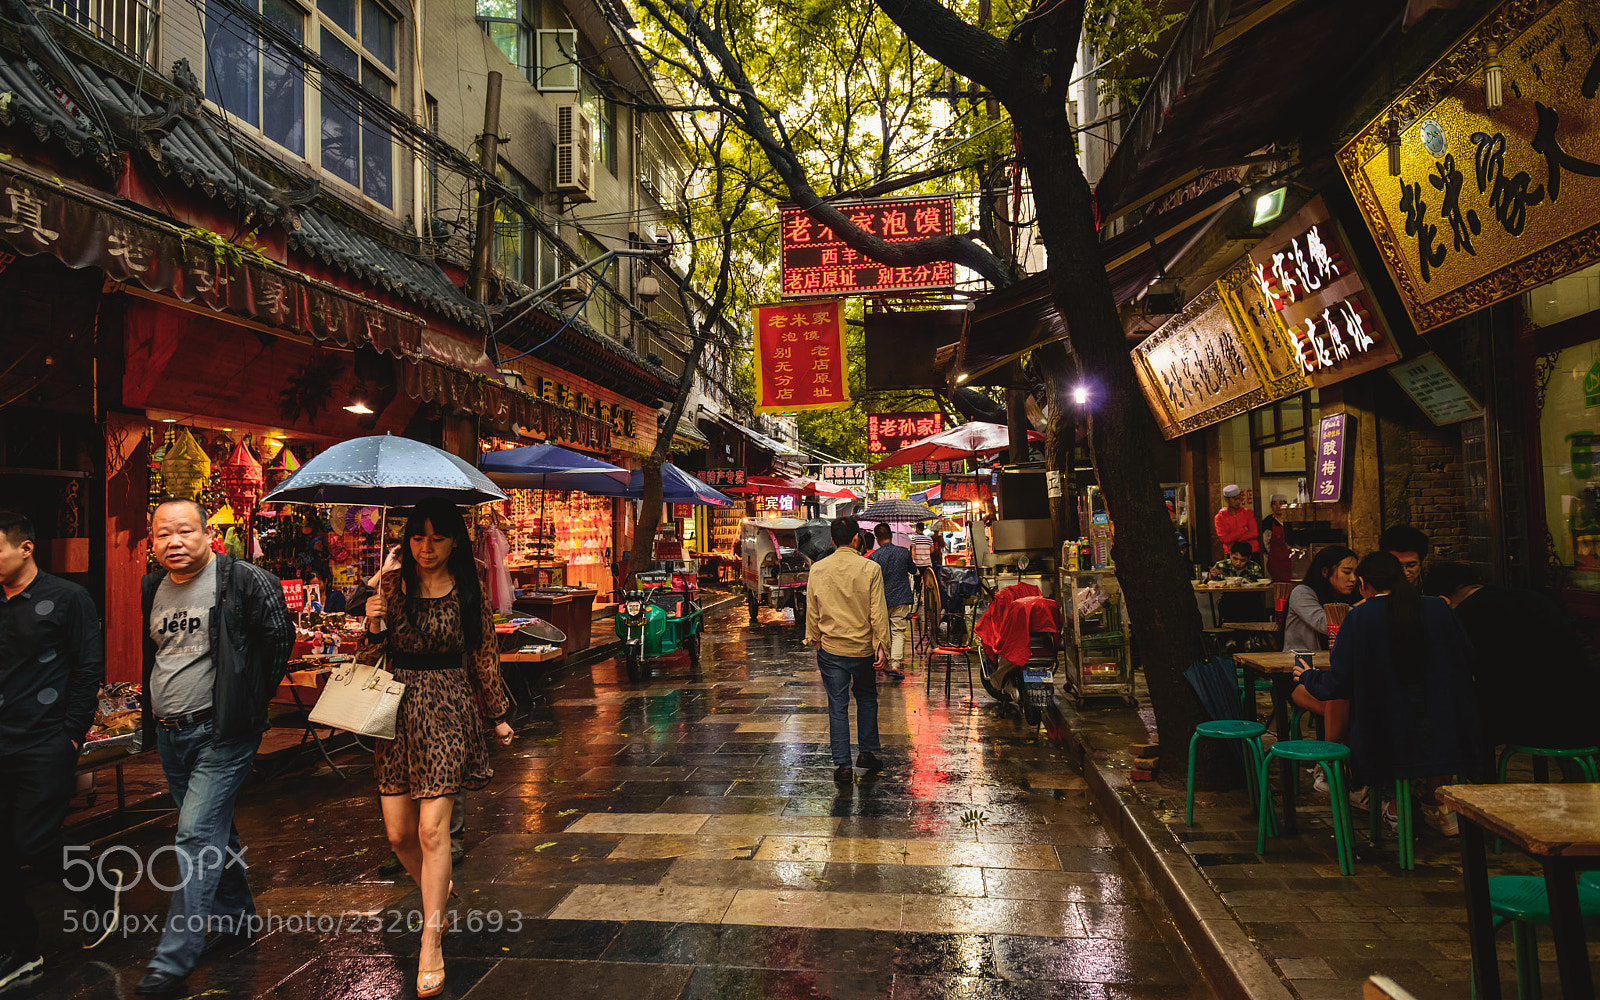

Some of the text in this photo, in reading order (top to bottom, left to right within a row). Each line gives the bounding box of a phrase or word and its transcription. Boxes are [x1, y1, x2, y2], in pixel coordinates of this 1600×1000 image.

[786, 263, 950, 290] 老店原址 别无分店
[768, 311, 832, 328] 老米家
[781, 330, 820, 342] 泡馍
[773, 347, 795, 400] 别无分店
[811, 345, 833, 398] 老店原址
[879, 418, 934, 437] 老孙家
[1320, 440, 1337, 496] 酸梅汤
[765, 495, 793, 510] 宾馆
[158, 616, 201, 635] Jeep
